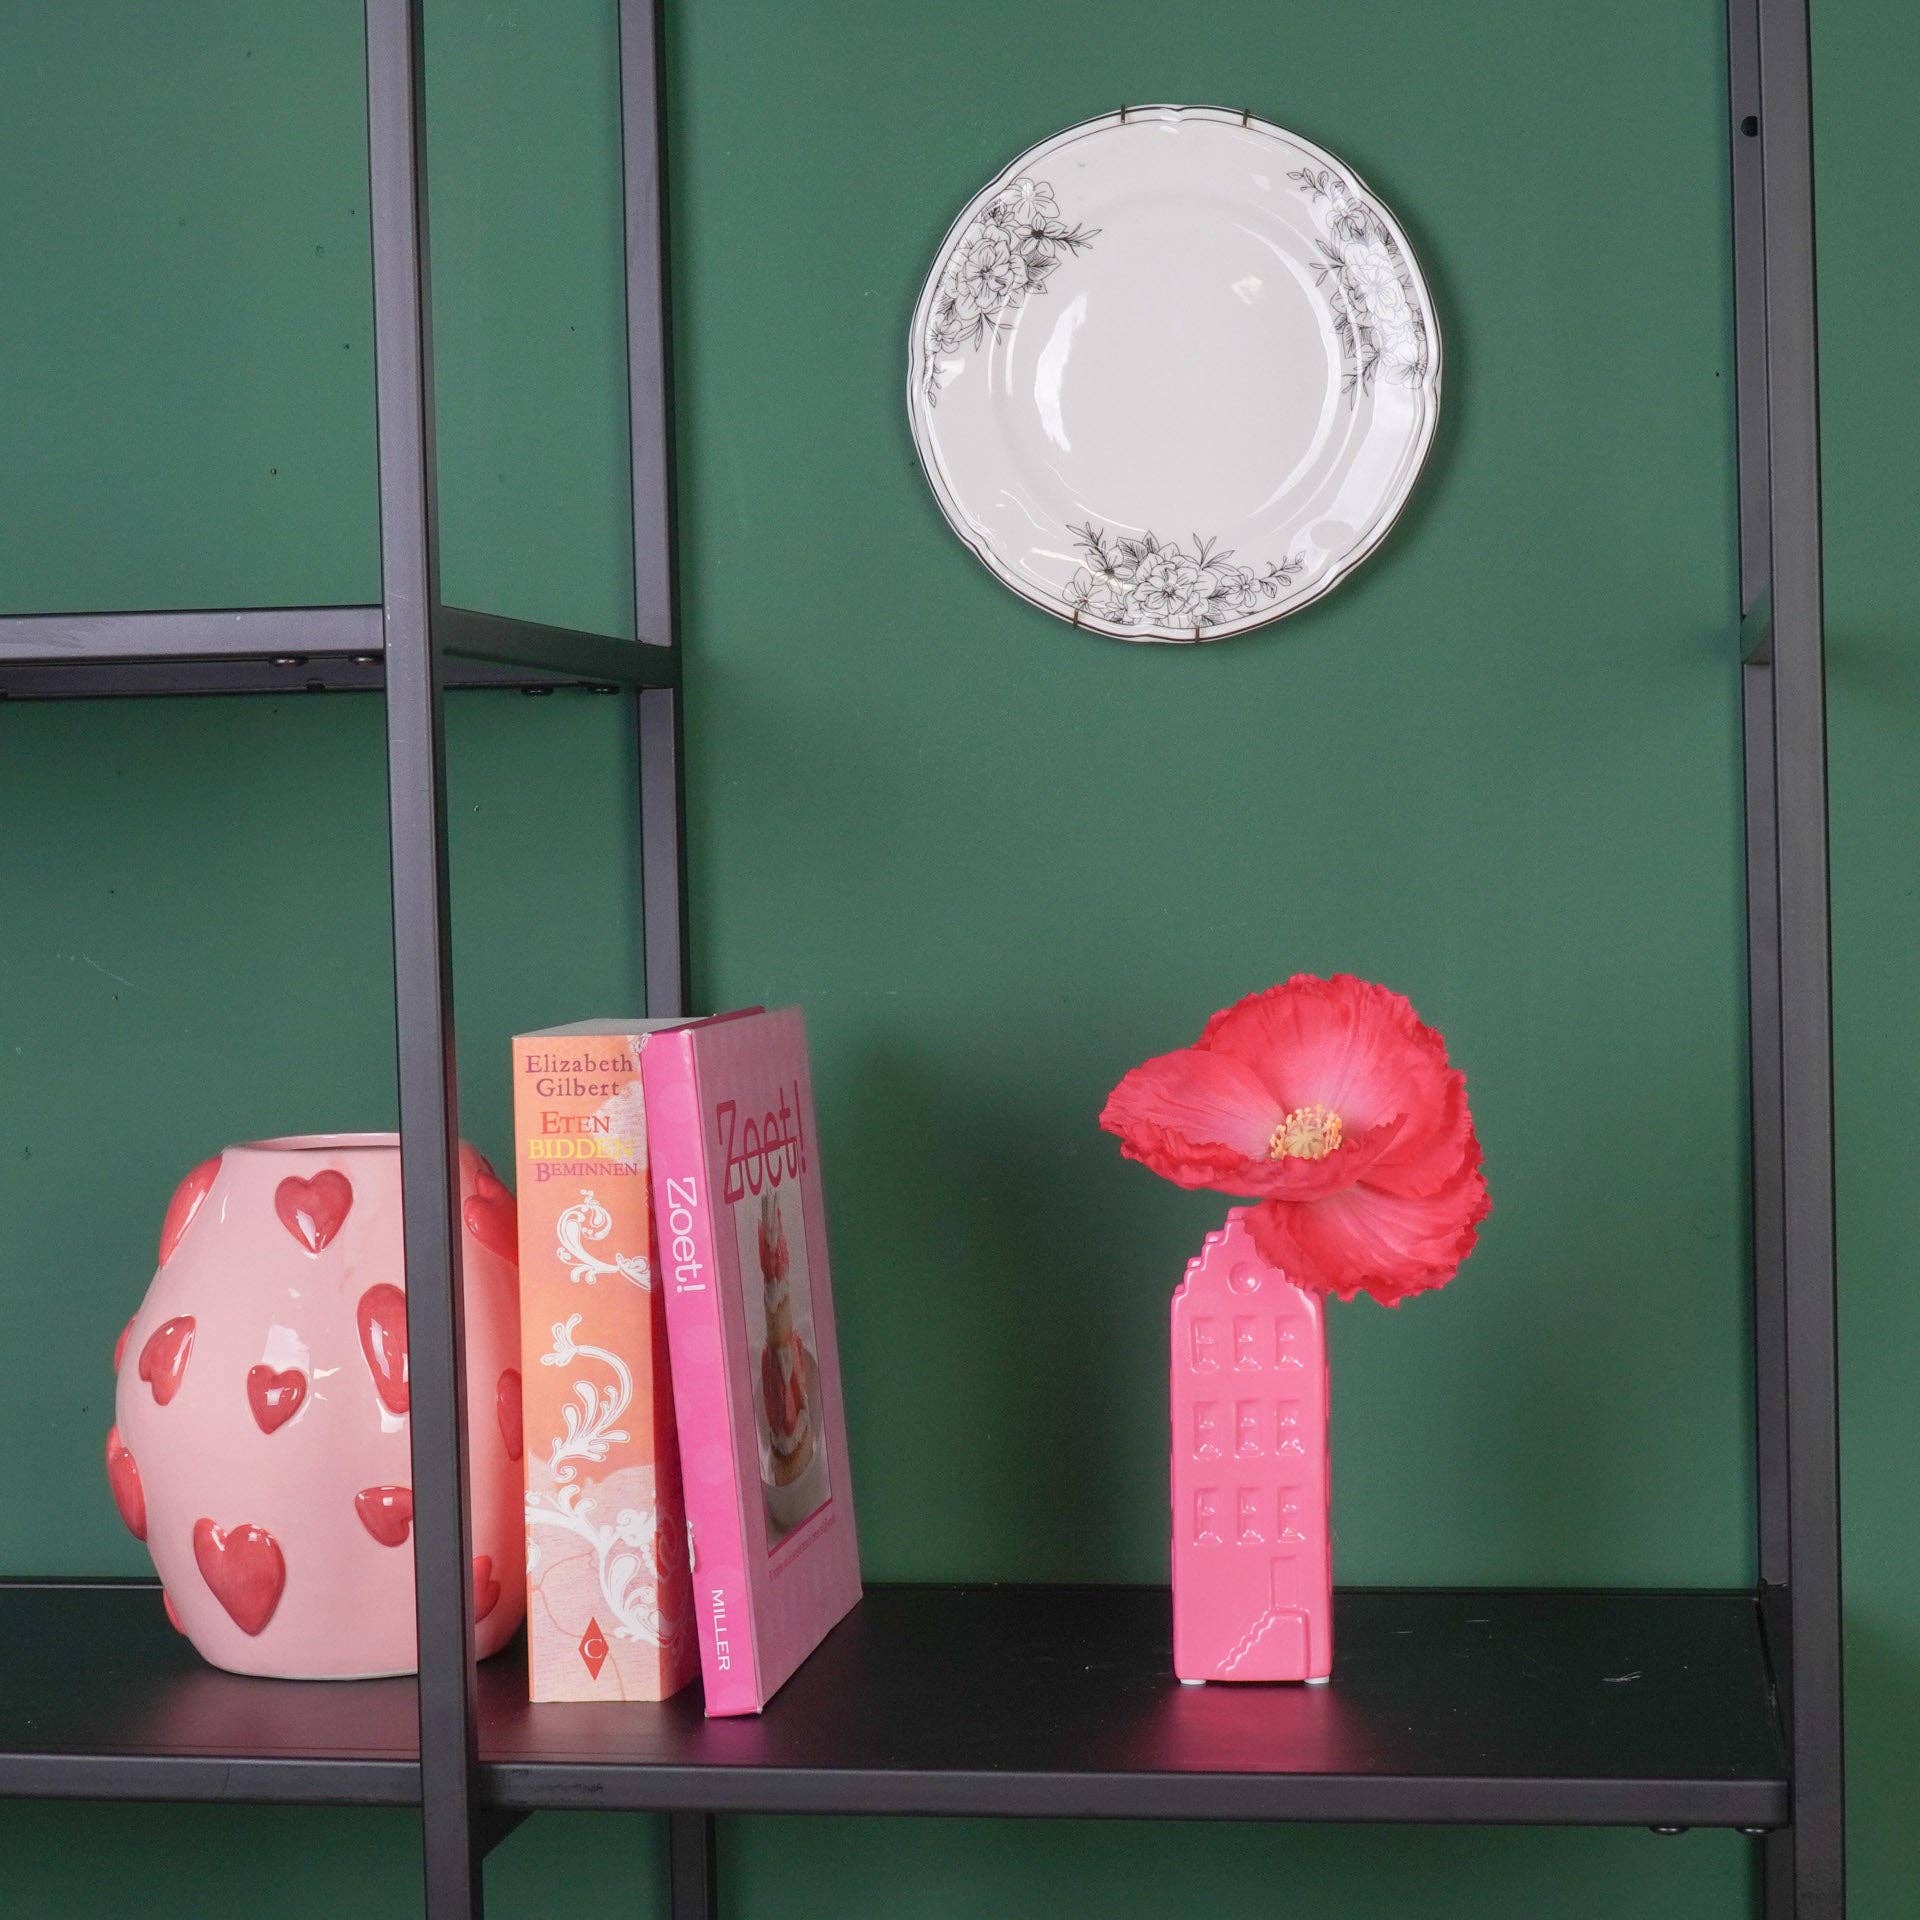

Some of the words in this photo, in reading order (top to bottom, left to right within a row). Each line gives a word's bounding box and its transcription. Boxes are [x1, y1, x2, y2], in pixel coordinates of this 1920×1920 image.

[526, 1054, 634, 1074] Elizabeth
[536, 1078, 620, 1098] Gilbert
[540, 1111, 611, 1135] ETEN
[527, 1138, 634, 1161] BIDDEN
[716, 1079, 807, 1205] Zoet!
[535, 1162, 638, 1183] BEMINNEN
[665, 1176, 707, 1294] Zoet!
[711, 1588, 731, 1672] MILLER
